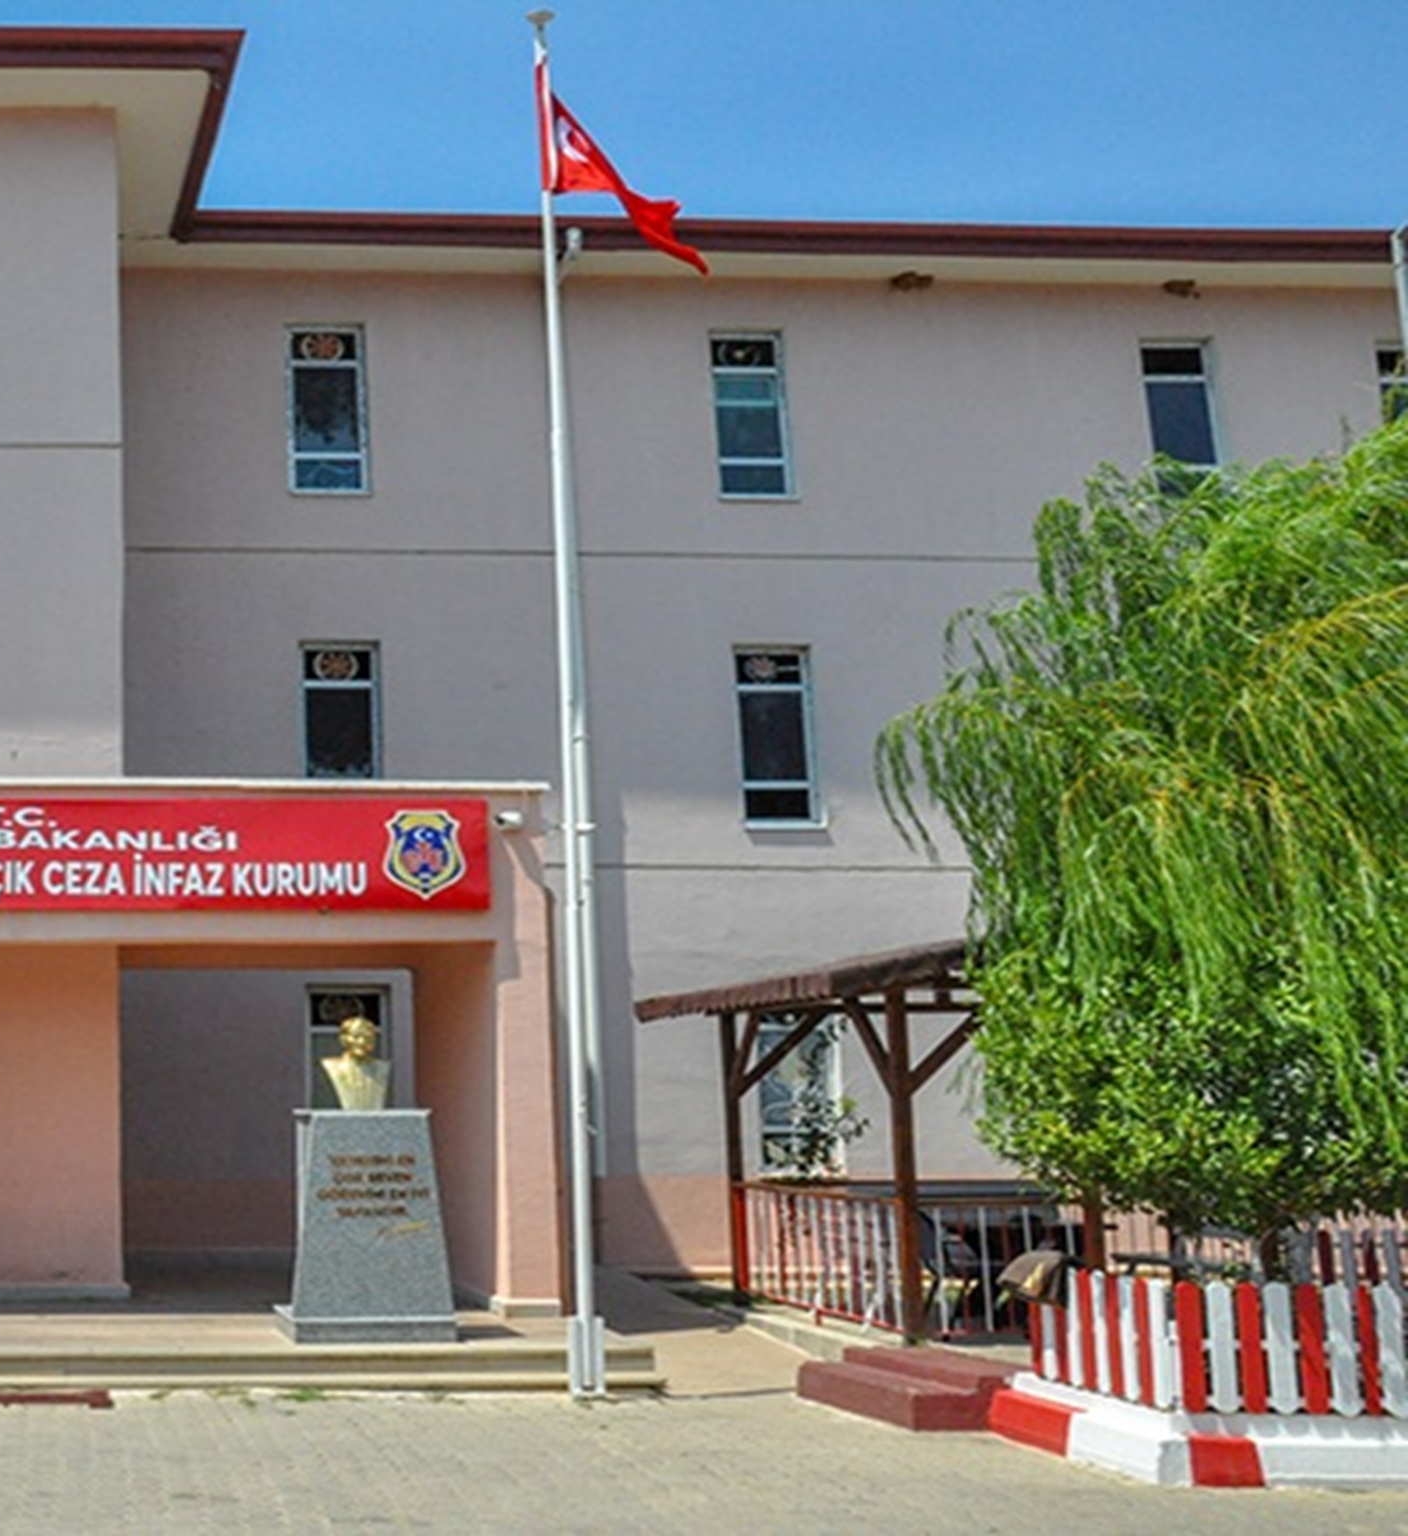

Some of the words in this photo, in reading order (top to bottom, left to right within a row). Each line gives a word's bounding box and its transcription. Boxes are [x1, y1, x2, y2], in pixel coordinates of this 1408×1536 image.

[42, 861, 126, 896] CEZA
[133, 852, 225, 897] İNFAZ
[232, 861, 368, 897] KURUMU
